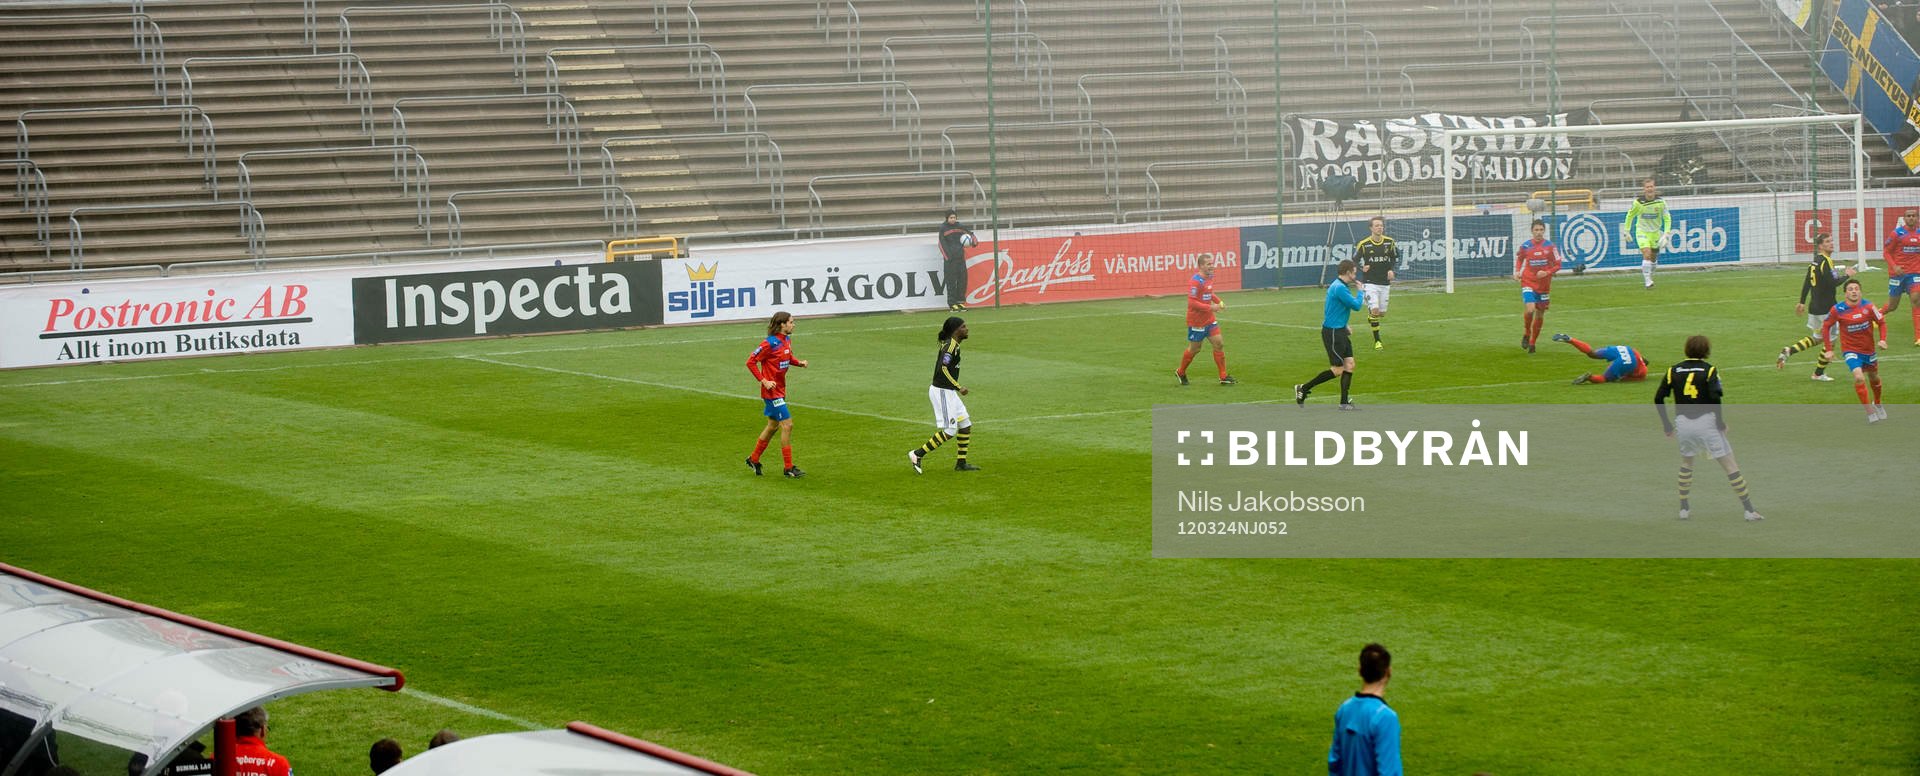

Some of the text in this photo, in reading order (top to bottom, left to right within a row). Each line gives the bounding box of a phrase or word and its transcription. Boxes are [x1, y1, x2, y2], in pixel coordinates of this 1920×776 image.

[1832, 18, 1907, 112] SOL INVICTUS
[1619, 218, 1728, 256] Ldab
[765, 266, 947, 306] TRÄGOLV
[966, 238, 1095, 304] Danfoss
[1810, 265, 1817, 287] 5
[44, 284, 309, 332] Postronic AB
[384, 266, 632, 335] Inspecta
[668, 281, 756, 318] siljan
[57, 329, 301, 361] Allt inom Butiksdata
[1683, 372, 1699, 399] 4
